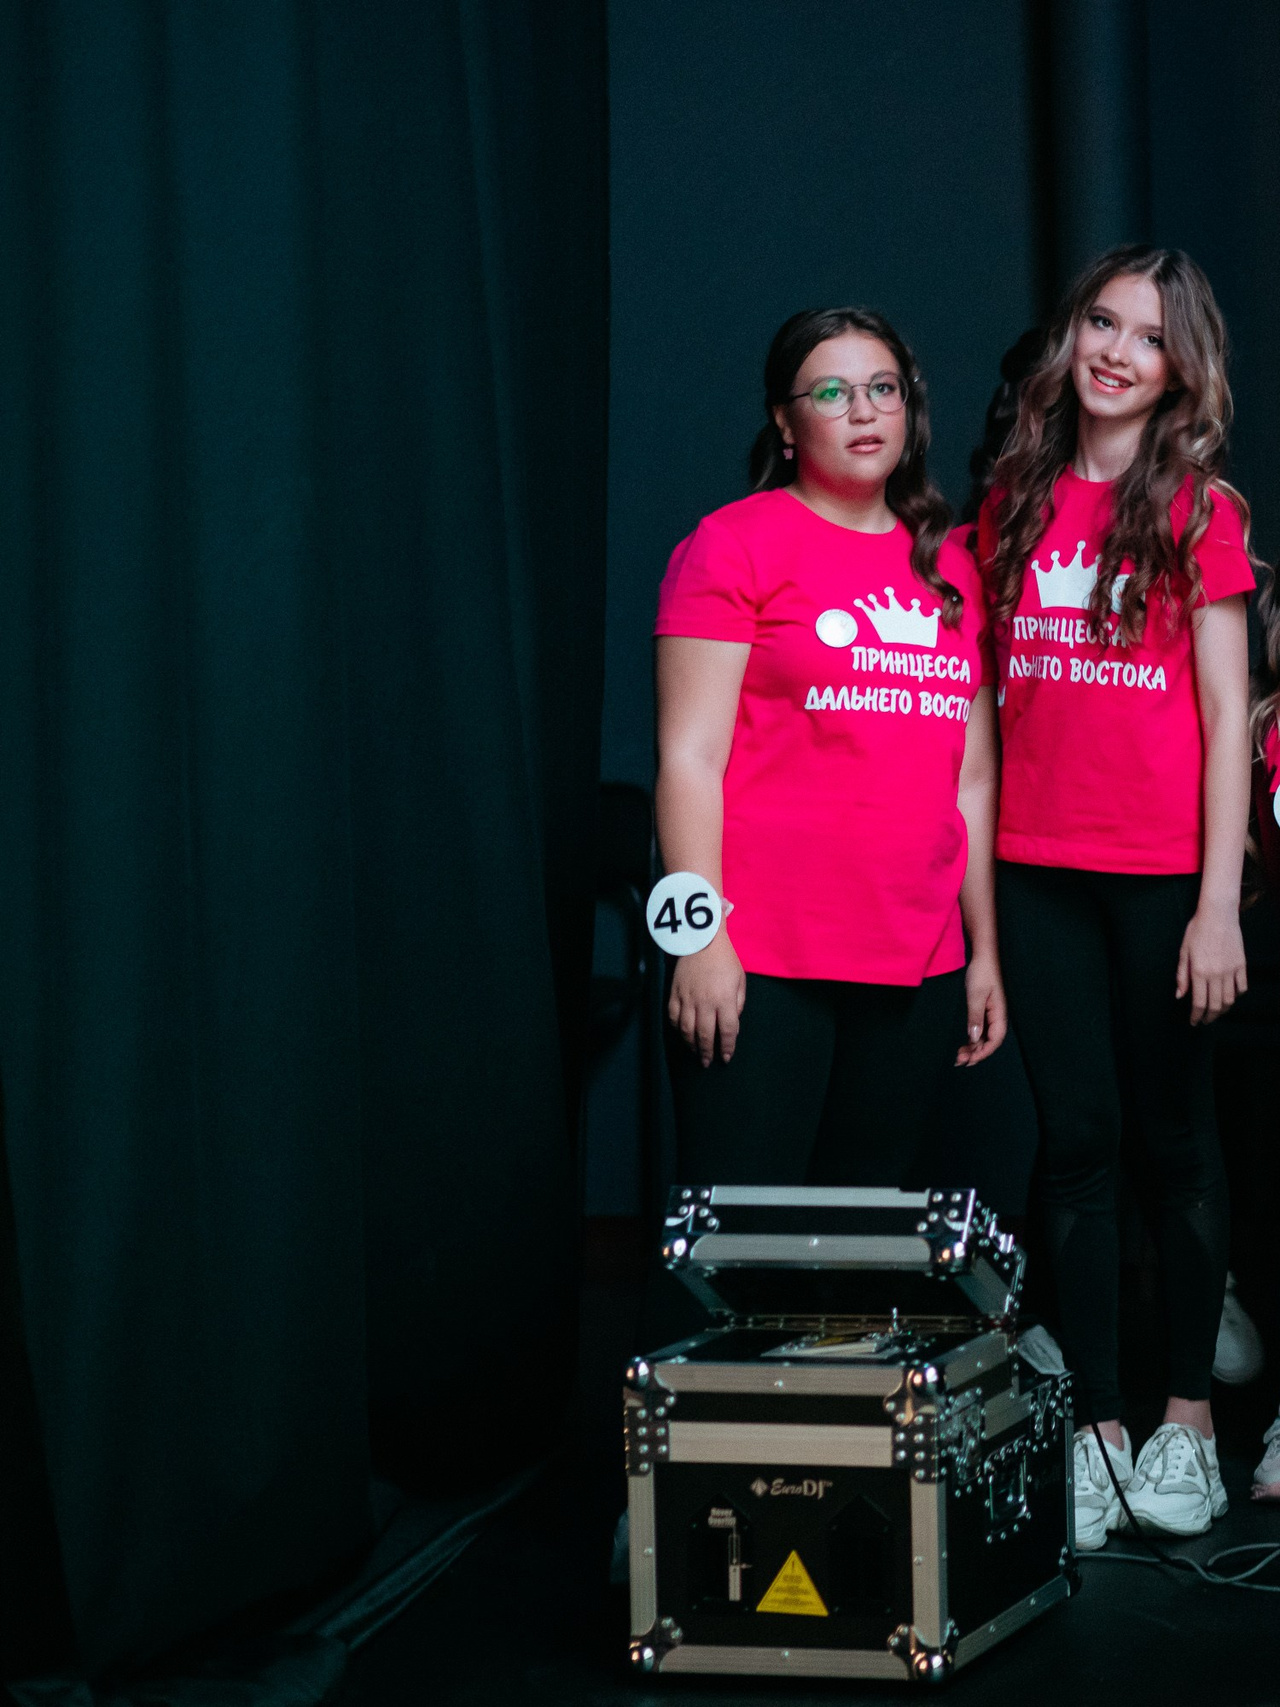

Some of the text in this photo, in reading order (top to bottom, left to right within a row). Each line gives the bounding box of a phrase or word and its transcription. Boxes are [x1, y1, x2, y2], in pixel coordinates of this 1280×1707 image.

[851, 646, 970, 684] ПРИНЦЕССА
[1070, 657, 1166, 691] ВОСТОКА
[804, 685, 912, 715] ДАЛЬНЕГО
[653, 892, 714, 934] 46
